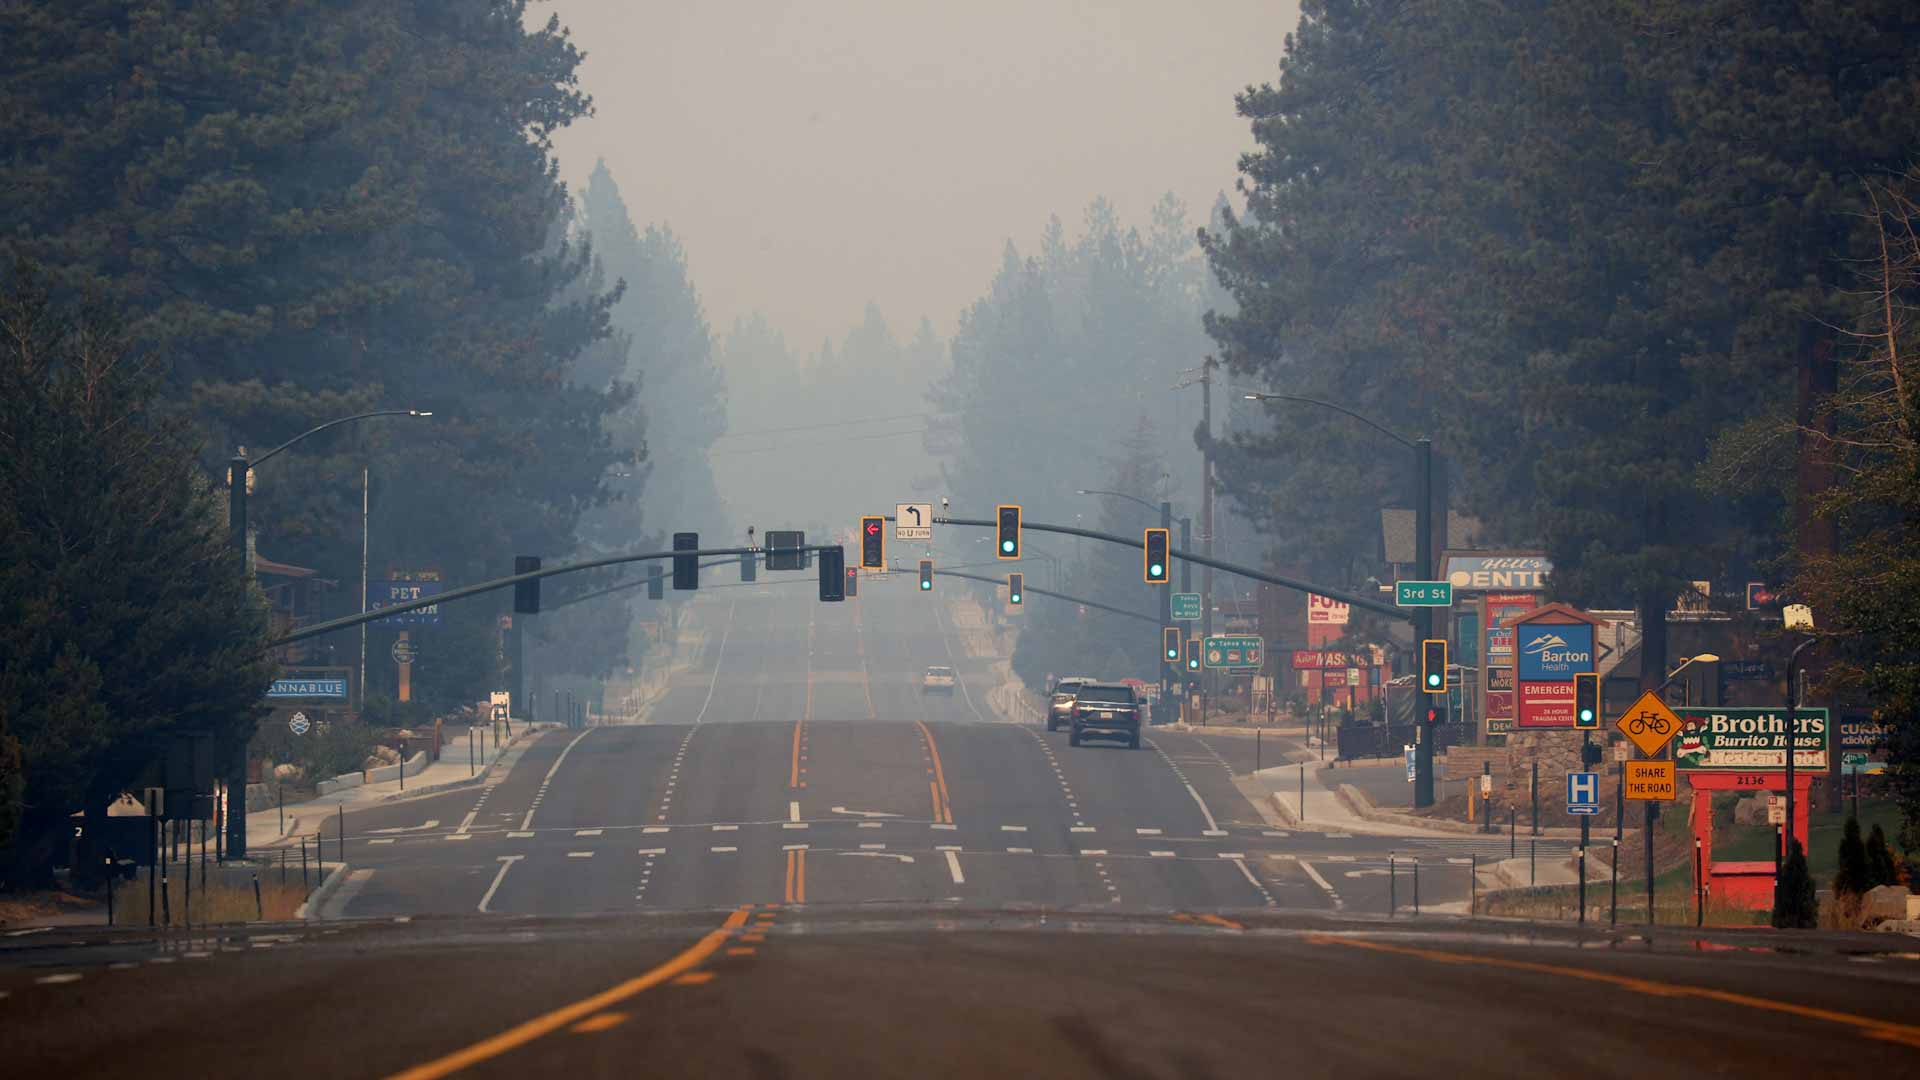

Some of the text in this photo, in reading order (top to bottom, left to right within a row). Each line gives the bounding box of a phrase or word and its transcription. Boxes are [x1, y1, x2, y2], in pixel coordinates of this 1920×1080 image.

[391, 587, 421, 600] PET
[1403, 588, 1446, 599] 3rd St
[1542, 651, 1589, 662] Barton
[1542, 662, 1570, 671] Health
[268, 684, 342, 693] ANNABLUE
[1525, 686, 1573, 695] EMERGEN
[1714, 735, 1821, 747] Burrito Huse
[1635, 768, 1666, 778] SHARE
[1737, 776, 1764, 785] 2136
[1571, 774, 1594, 803] H
[1629, 783, 1671, 793] THE ROAD
